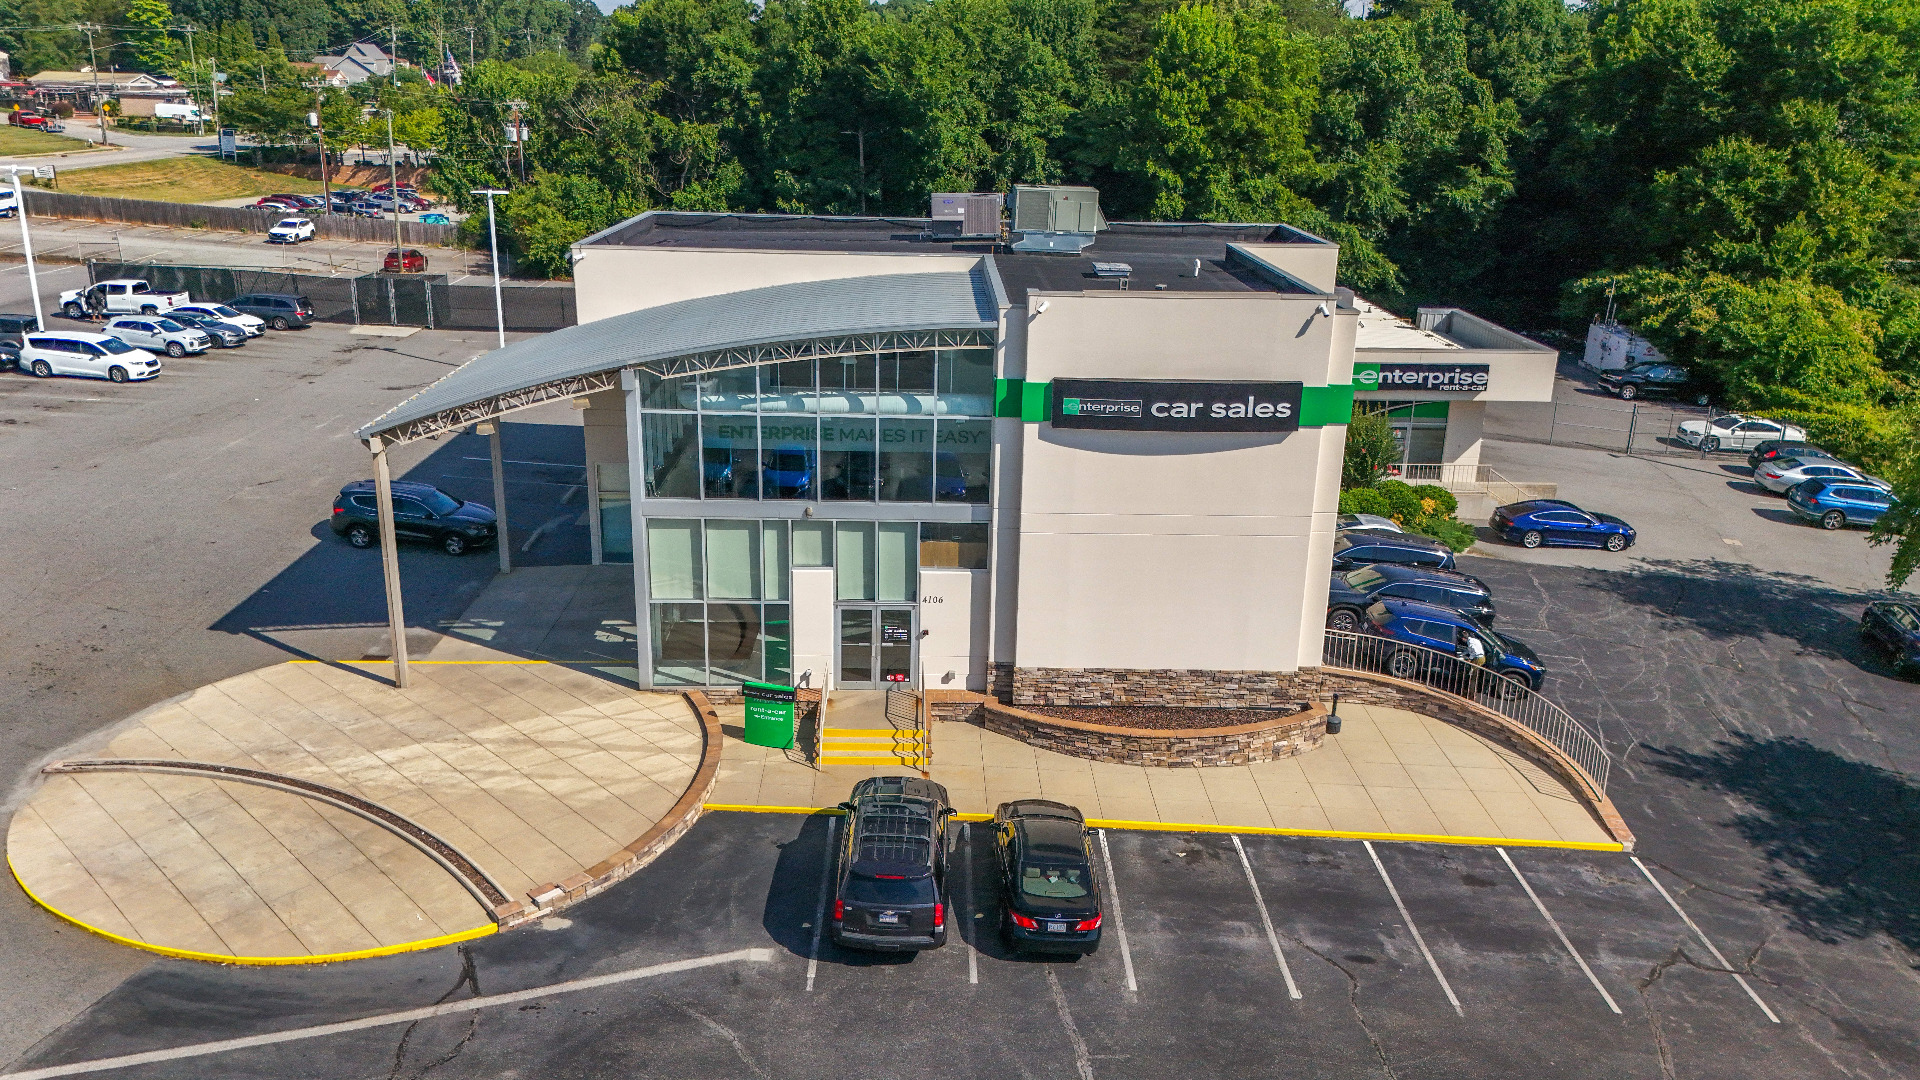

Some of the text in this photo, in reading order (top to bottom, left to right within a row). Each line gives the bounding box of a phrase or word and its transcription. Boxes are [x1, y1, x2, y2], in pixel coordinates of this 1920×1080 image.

[1352, 368, 1488, 388] enterprise
[1063, 395, 1292, 418] enterprise car sales
[718, 425, 835, 441] ENTERPRISE
[839, 428, 906, 443] MAKES
[911, 429, 927, 443] IT
[921, 595, 943, 604] 4106
